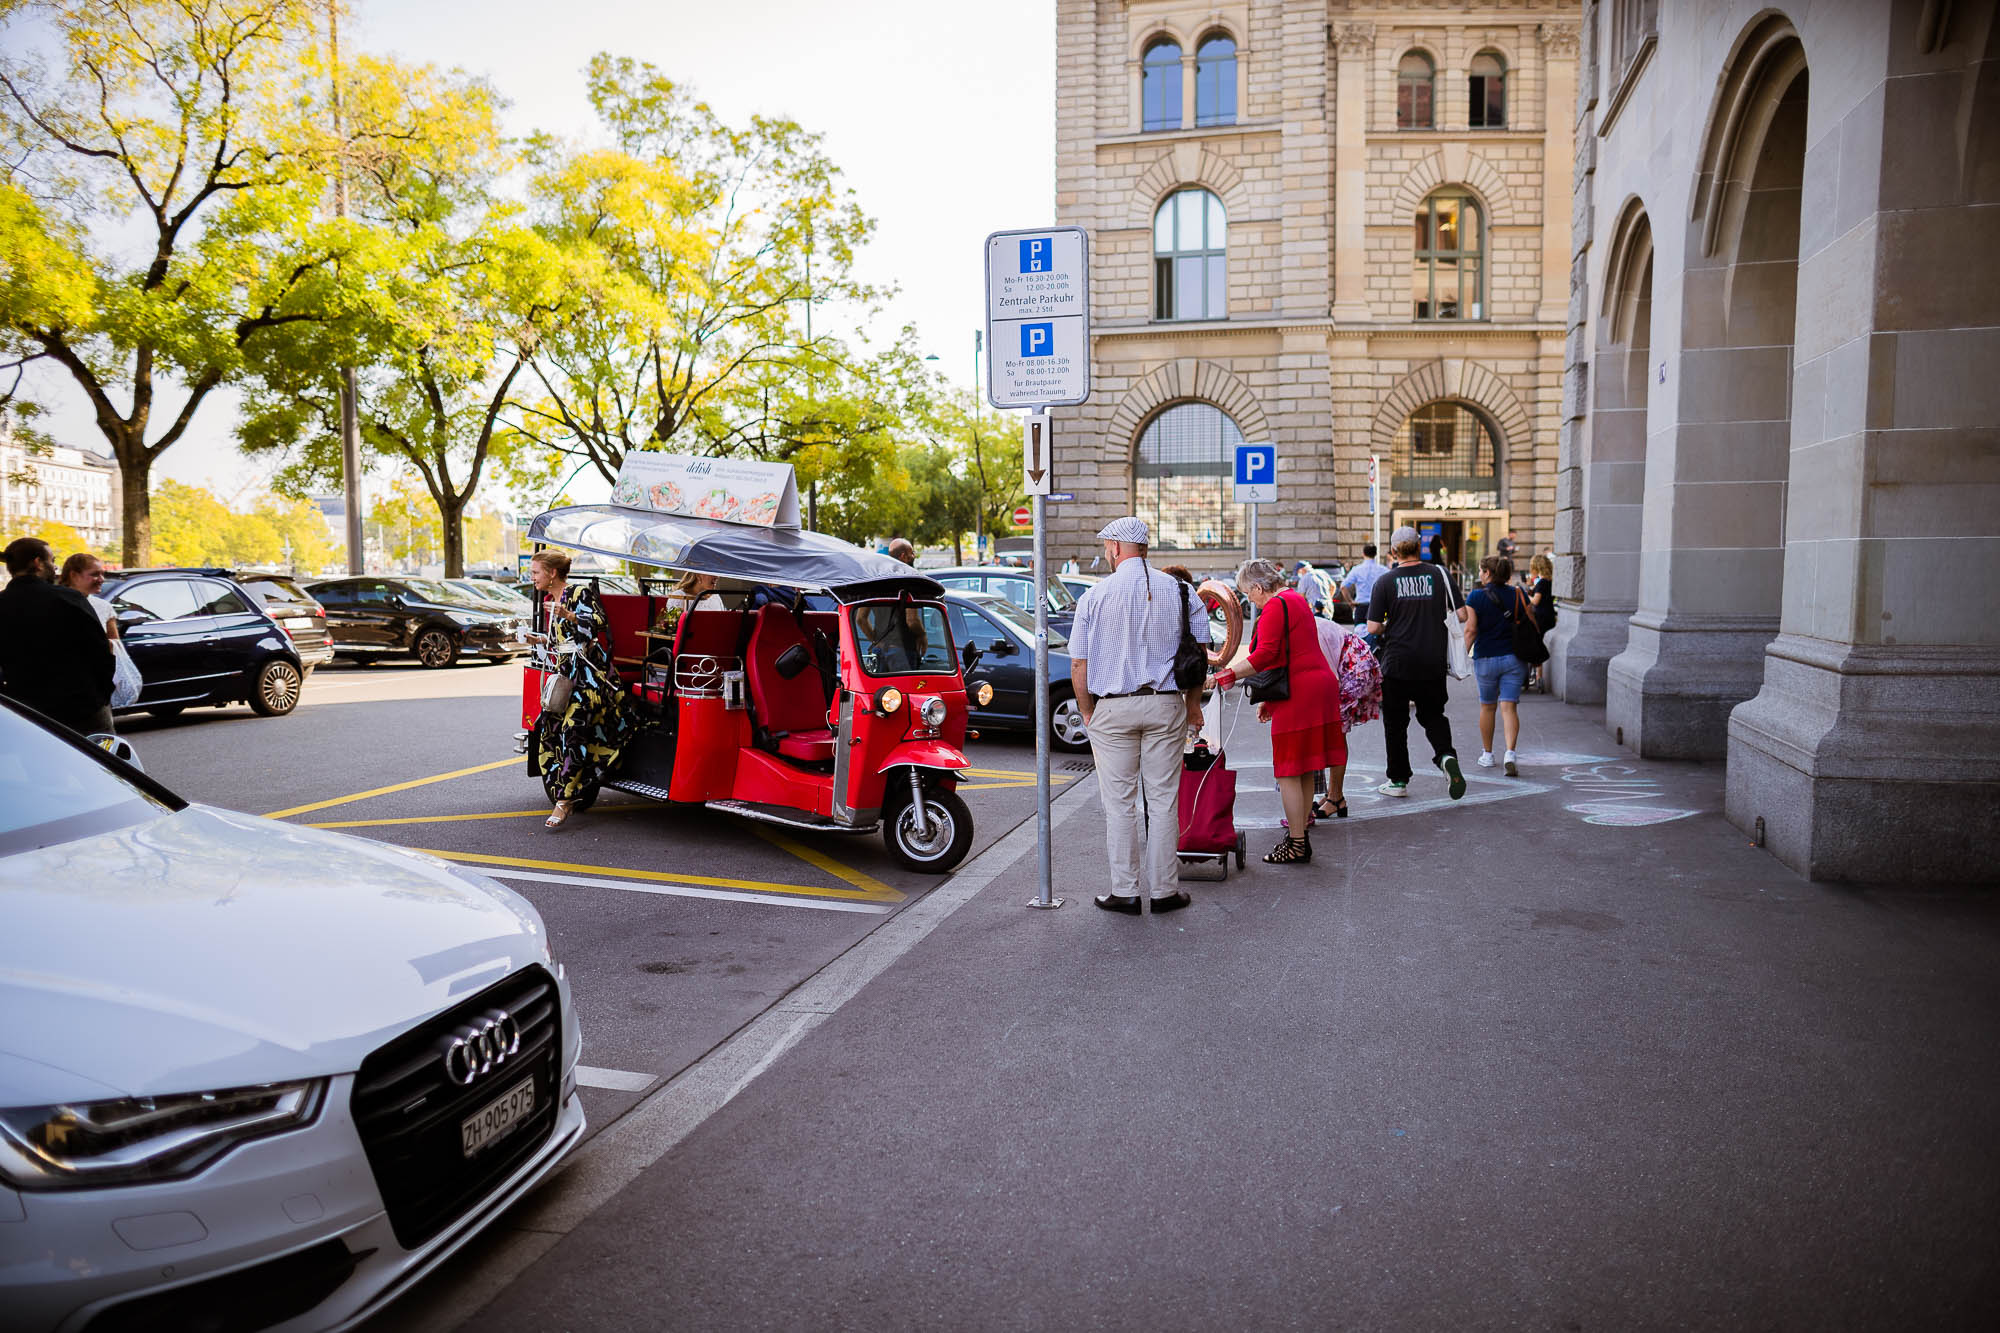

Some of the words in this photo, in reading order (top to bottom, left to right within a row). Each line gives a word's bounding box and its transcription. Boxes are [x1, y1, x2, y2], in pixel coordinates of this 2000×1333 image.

[1031, 241, 1042, 259] P
[999, 295, 1037, 307] Zentrale
[1040, 293, 1074, 304] Parkuhr
[1042, 305, 1055, 313] Std.
[1030, 328, 1046, 353] P
[1005, 360, 1025, 368] Mo-Fr
[1006, 369, 1015, 377] Sa
[1025, 378, 1062, 387] Brautpaare
[1040, 388, 1066, 396] Trauung
[685, 461, 712, 475] delish
[1246, 452, 1265, 481] P
[1396, 575, 1432, 598] ANALOG
[485, 1099, 508, 1136] 905
[511, 1083, 533, 1118] 975
